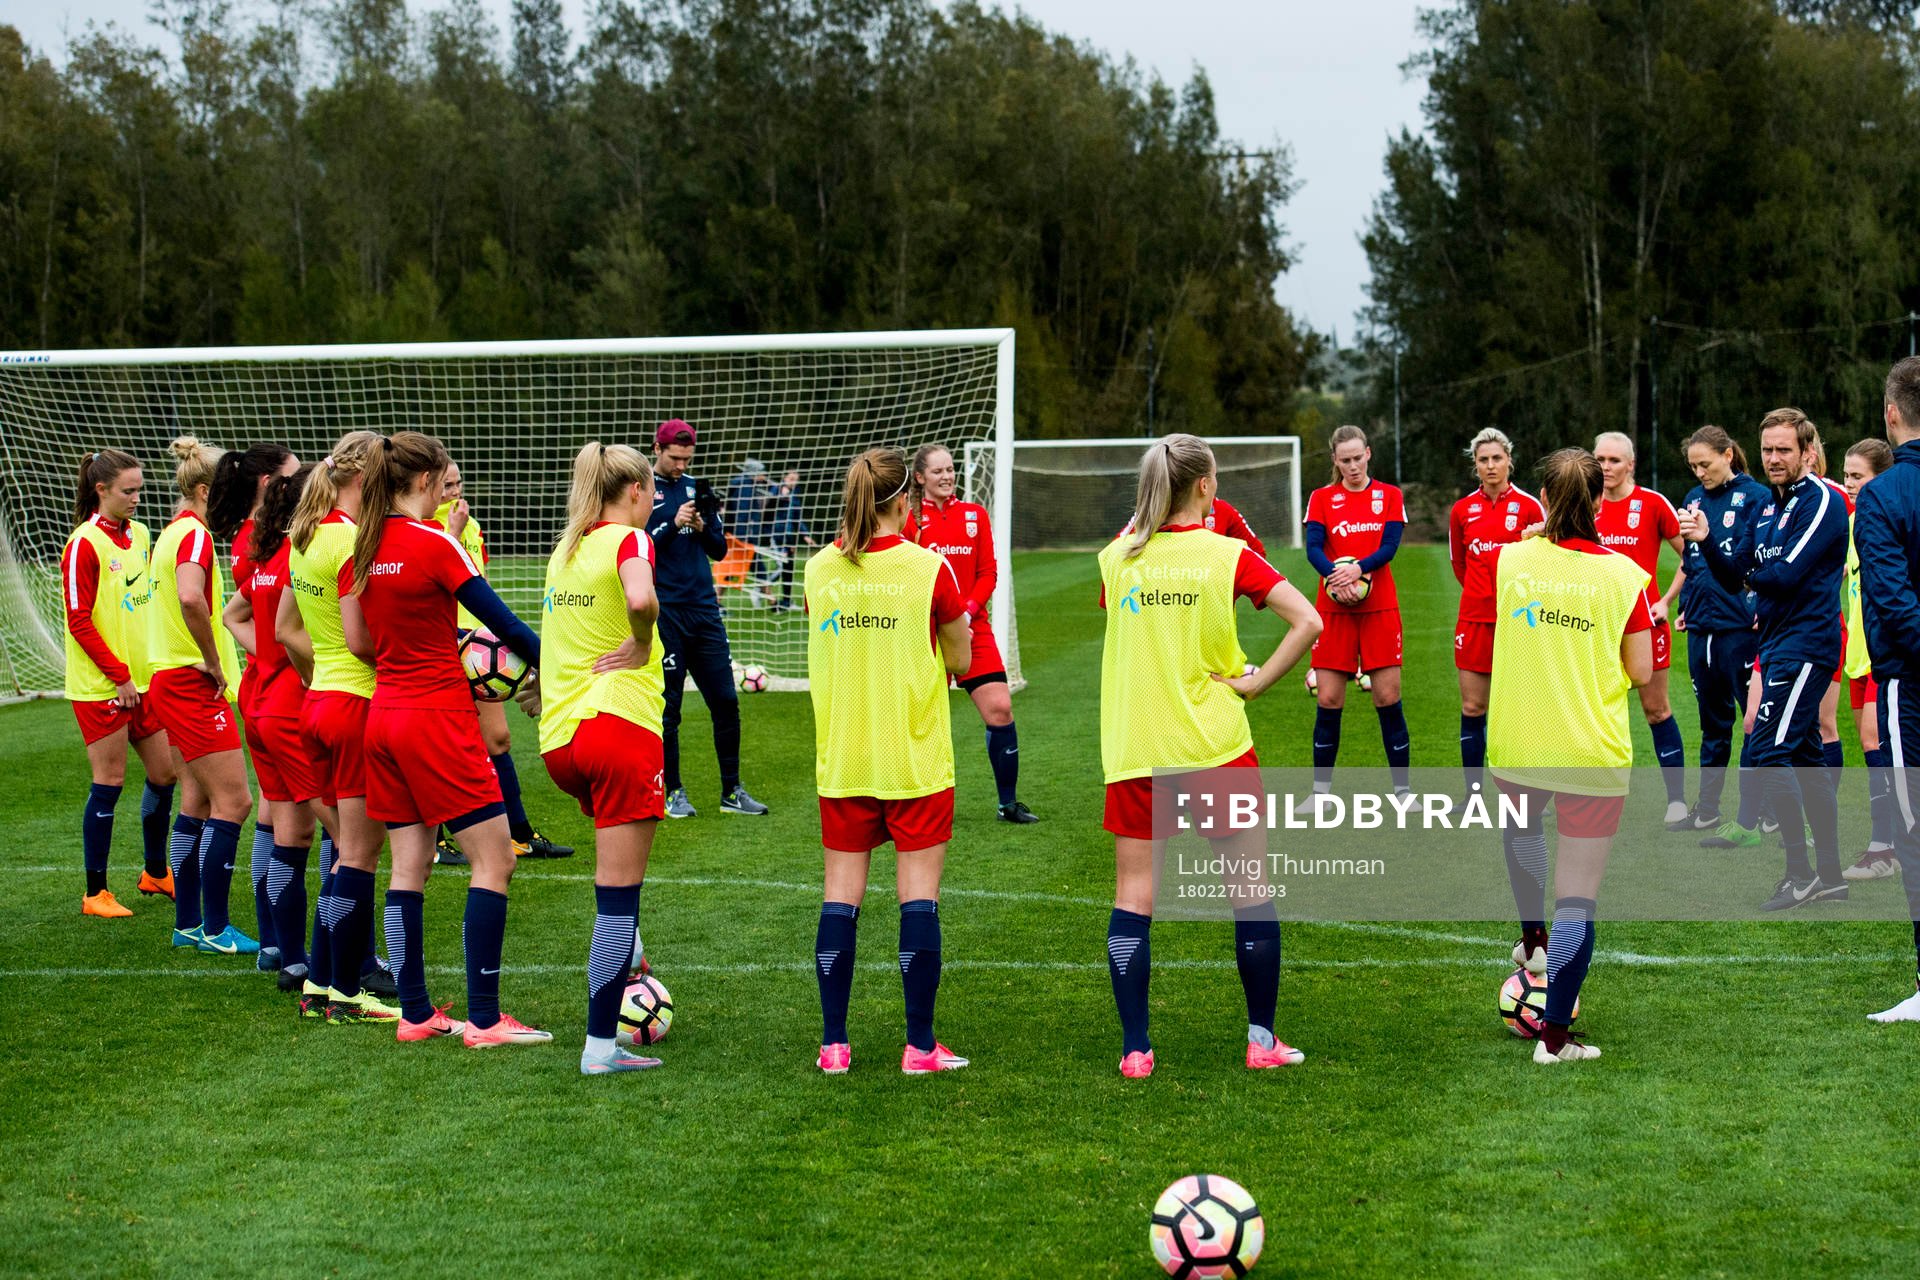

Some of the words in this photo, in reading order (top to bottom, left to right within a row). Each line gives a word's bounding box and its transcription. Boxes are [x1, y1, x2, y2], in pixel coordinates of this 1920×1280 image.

[1346, 522, 1383, 533] telenor
[1601, 533, 1639, 546] telenor
[936, 544, 972, 555] telenor
[368, 561, 404, 575] elenor
[293, 576, 325, 597] telenor
[553, 590, 596, 607] telenor
[1140, 589, 1199, 606] telenor
[839, 612, 898, 629] telenor
